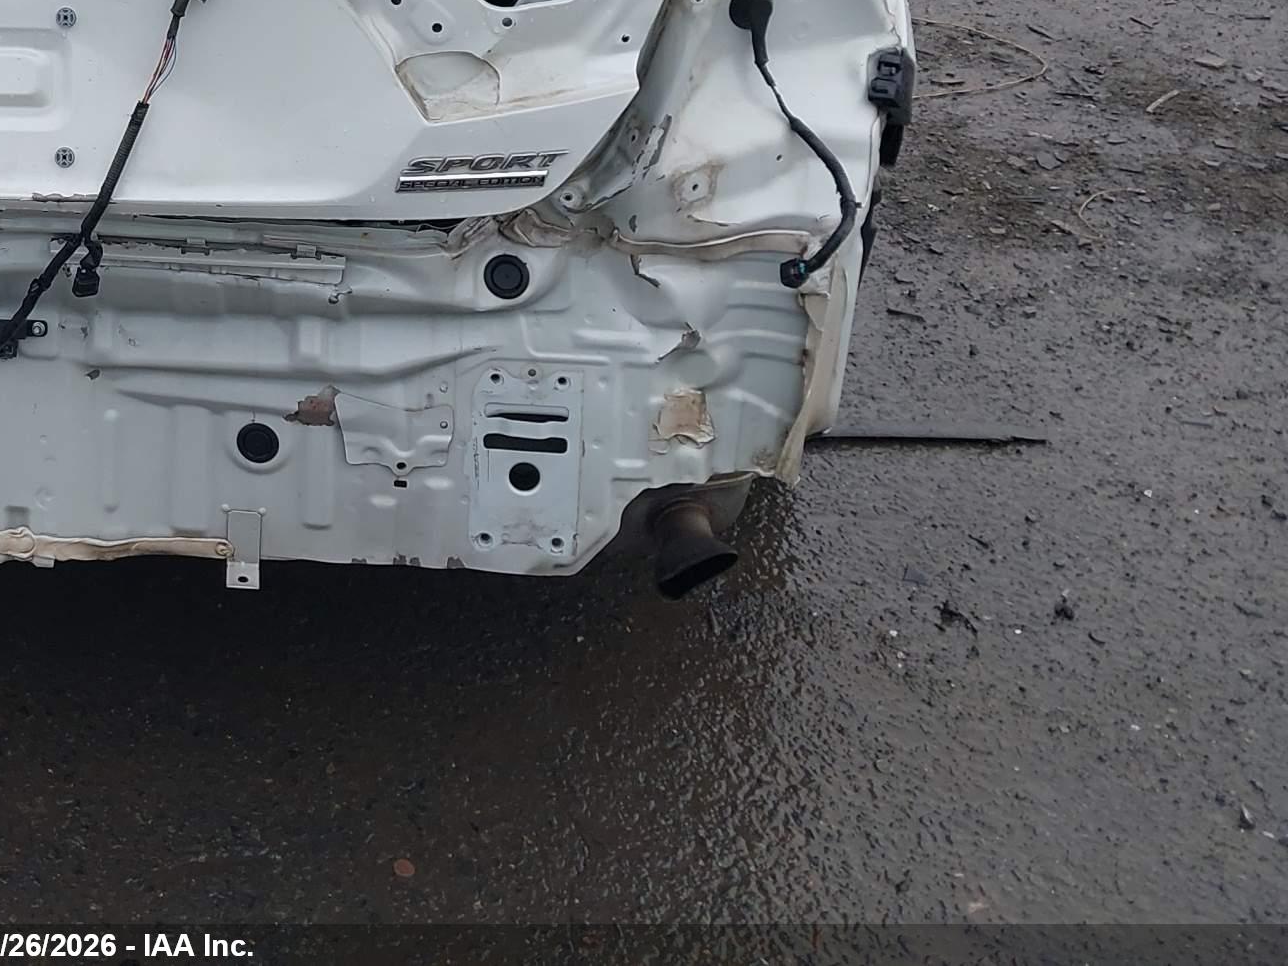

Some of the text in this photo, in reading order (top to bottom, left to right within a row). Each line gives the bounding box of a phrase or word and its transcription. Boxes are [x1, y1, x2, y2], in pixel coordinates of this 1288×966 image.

[400, 149, 570, 173] SPORT
[400, 176, 545, 189] SPECIAL EDITION
